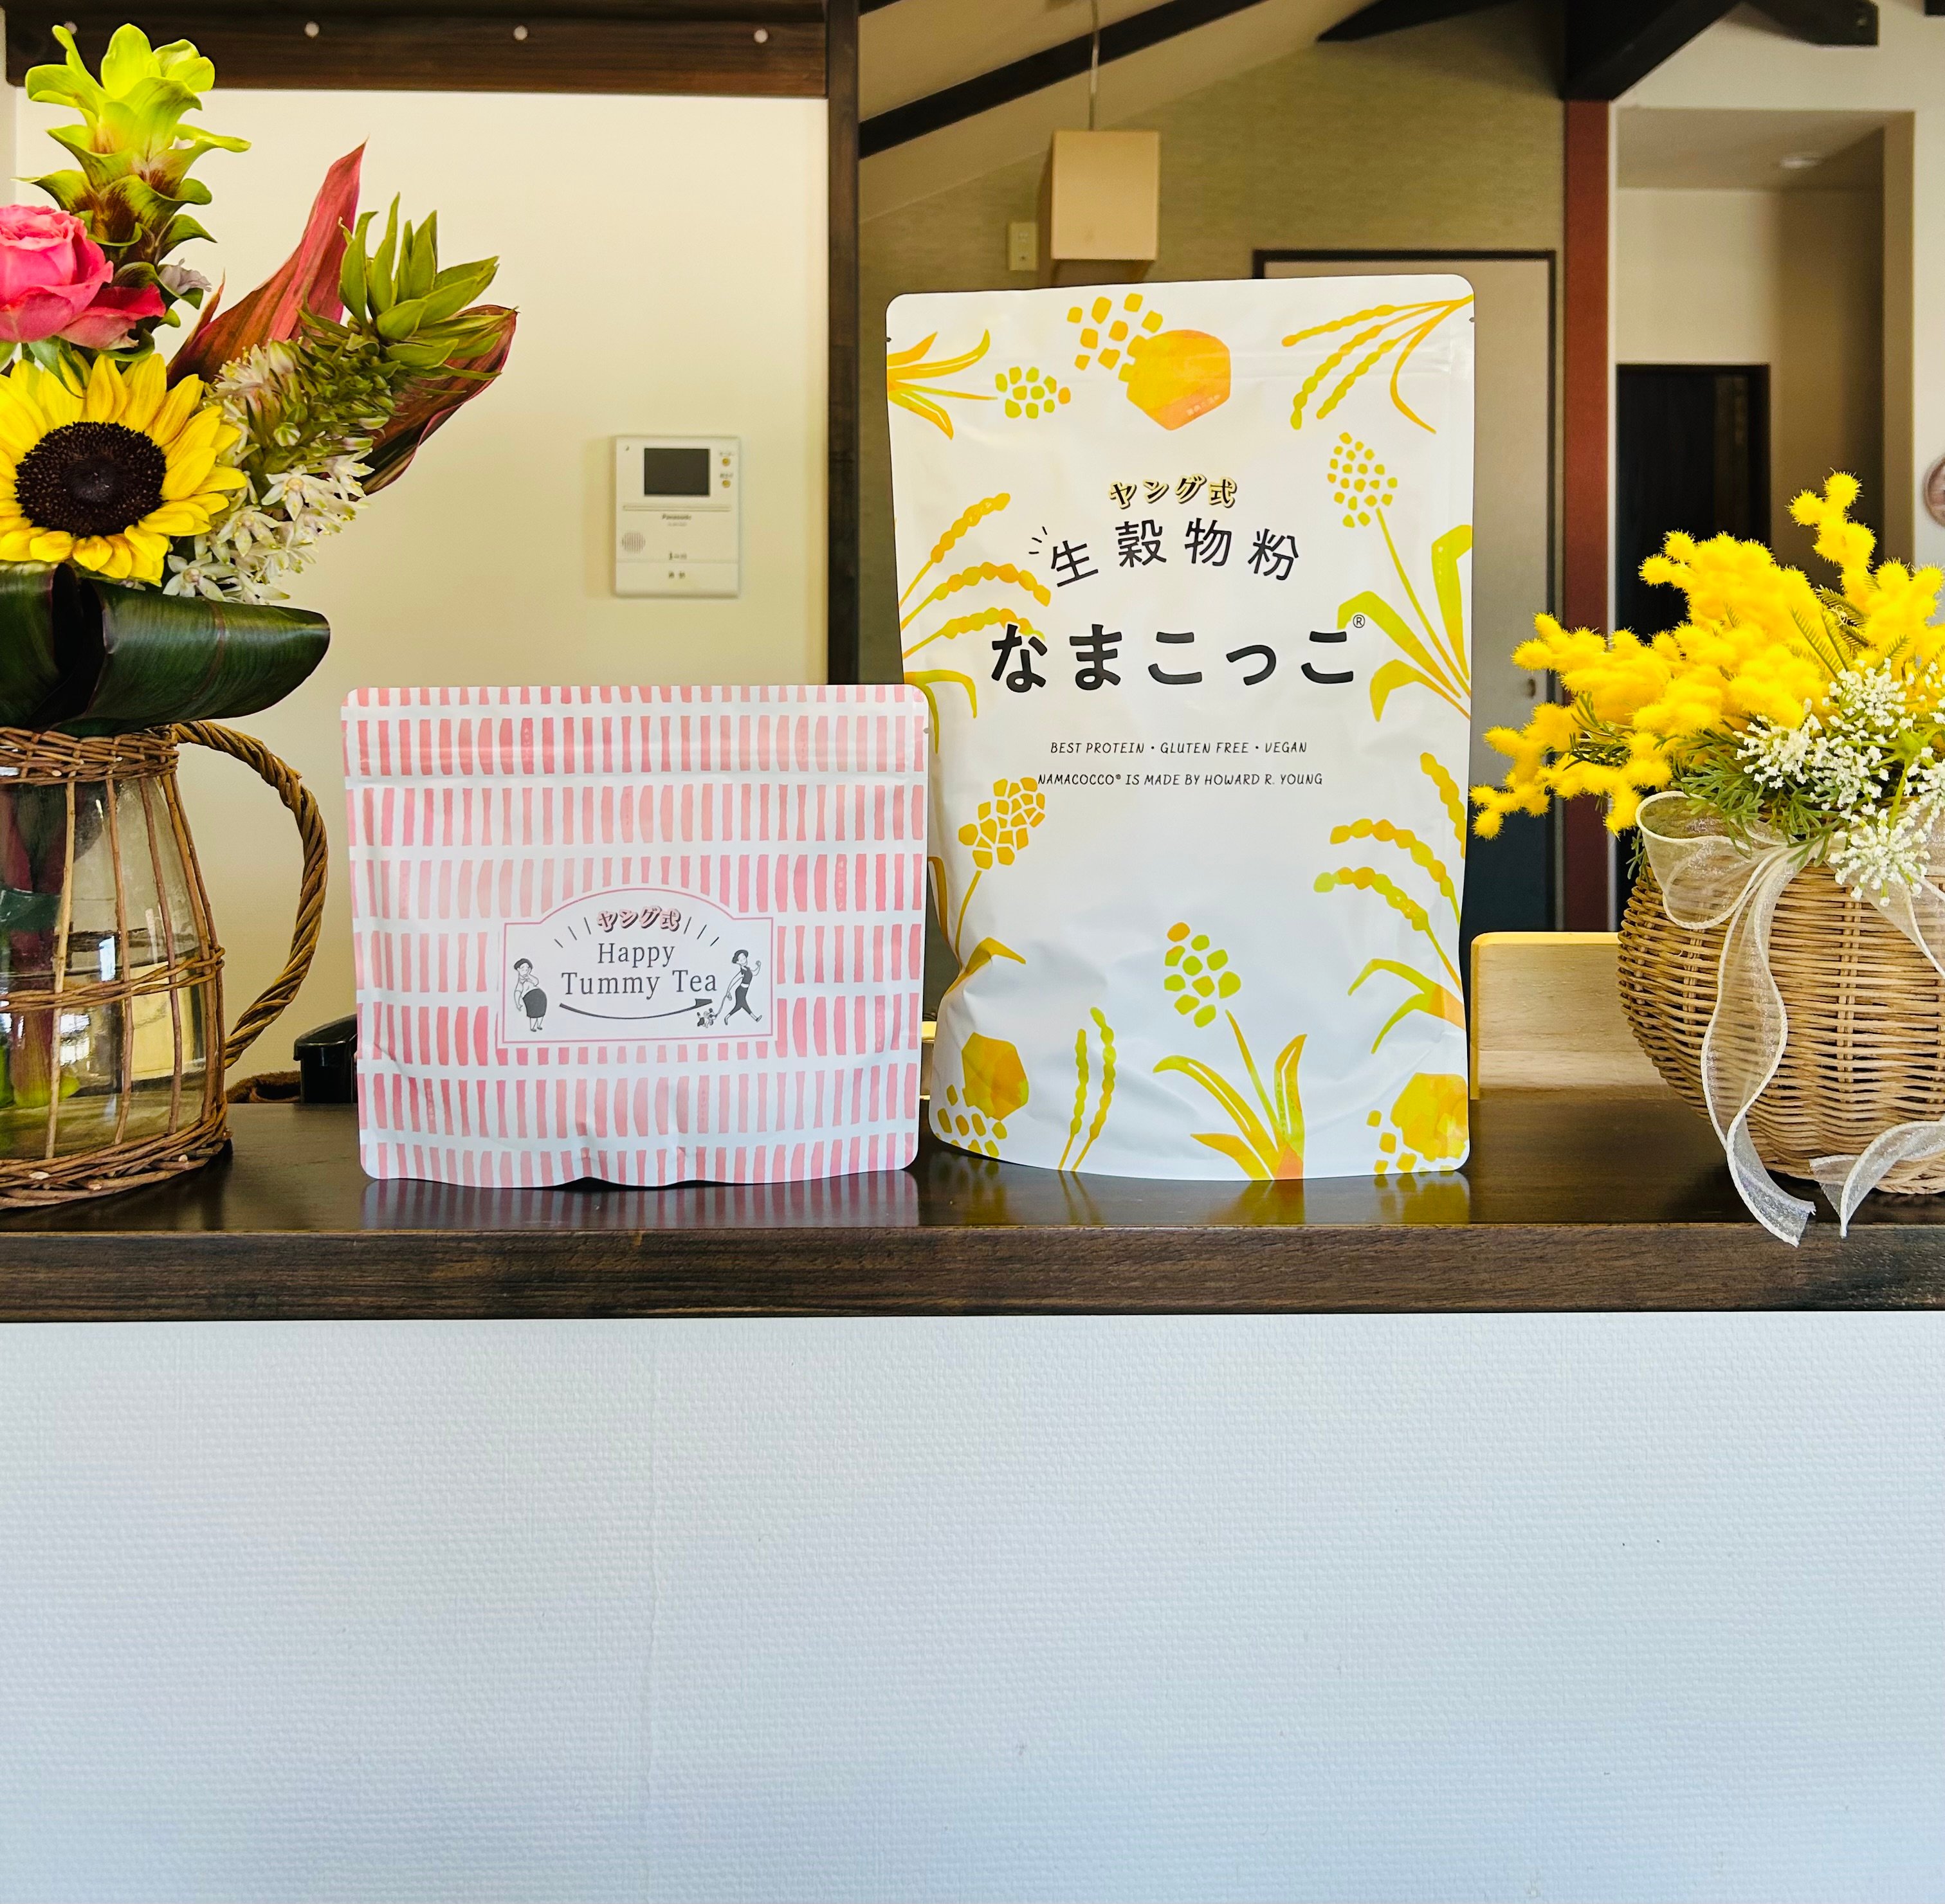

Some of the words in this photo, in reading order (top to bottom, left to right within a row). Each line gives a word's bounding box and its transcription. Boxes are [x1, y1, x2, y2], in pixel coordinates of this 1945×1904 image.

[1109, 474, 1237, 509] ヤング式
[1050, 518, 1299, 588] 生穀物粉
[1050, 741, 1082, 754] BEST
[1086, 742, 1144, 754] PROTEIN
[1160, 742, 1210, 754] GLUTEN
[1216, 742, 1249, 754] FREE
[1265, 741, 1307, 754] VEGAN
[1126, 774, 1140, 785] IS
[1144, 774, 1180, 785] MADE
[1185, 774, 1200, 785] BY
[1205, 774, 1260, 785] HOWARD
[1265, 774, 1275, 785] R.
[1281, 773, 1322, 785] YOUNG
[598, 905, 681, 932] ヤング式
[598, 943, 675, 968] Happy
[562, 972, 661, 1000] Tummy
[672, 970, 717, 992] Tea
